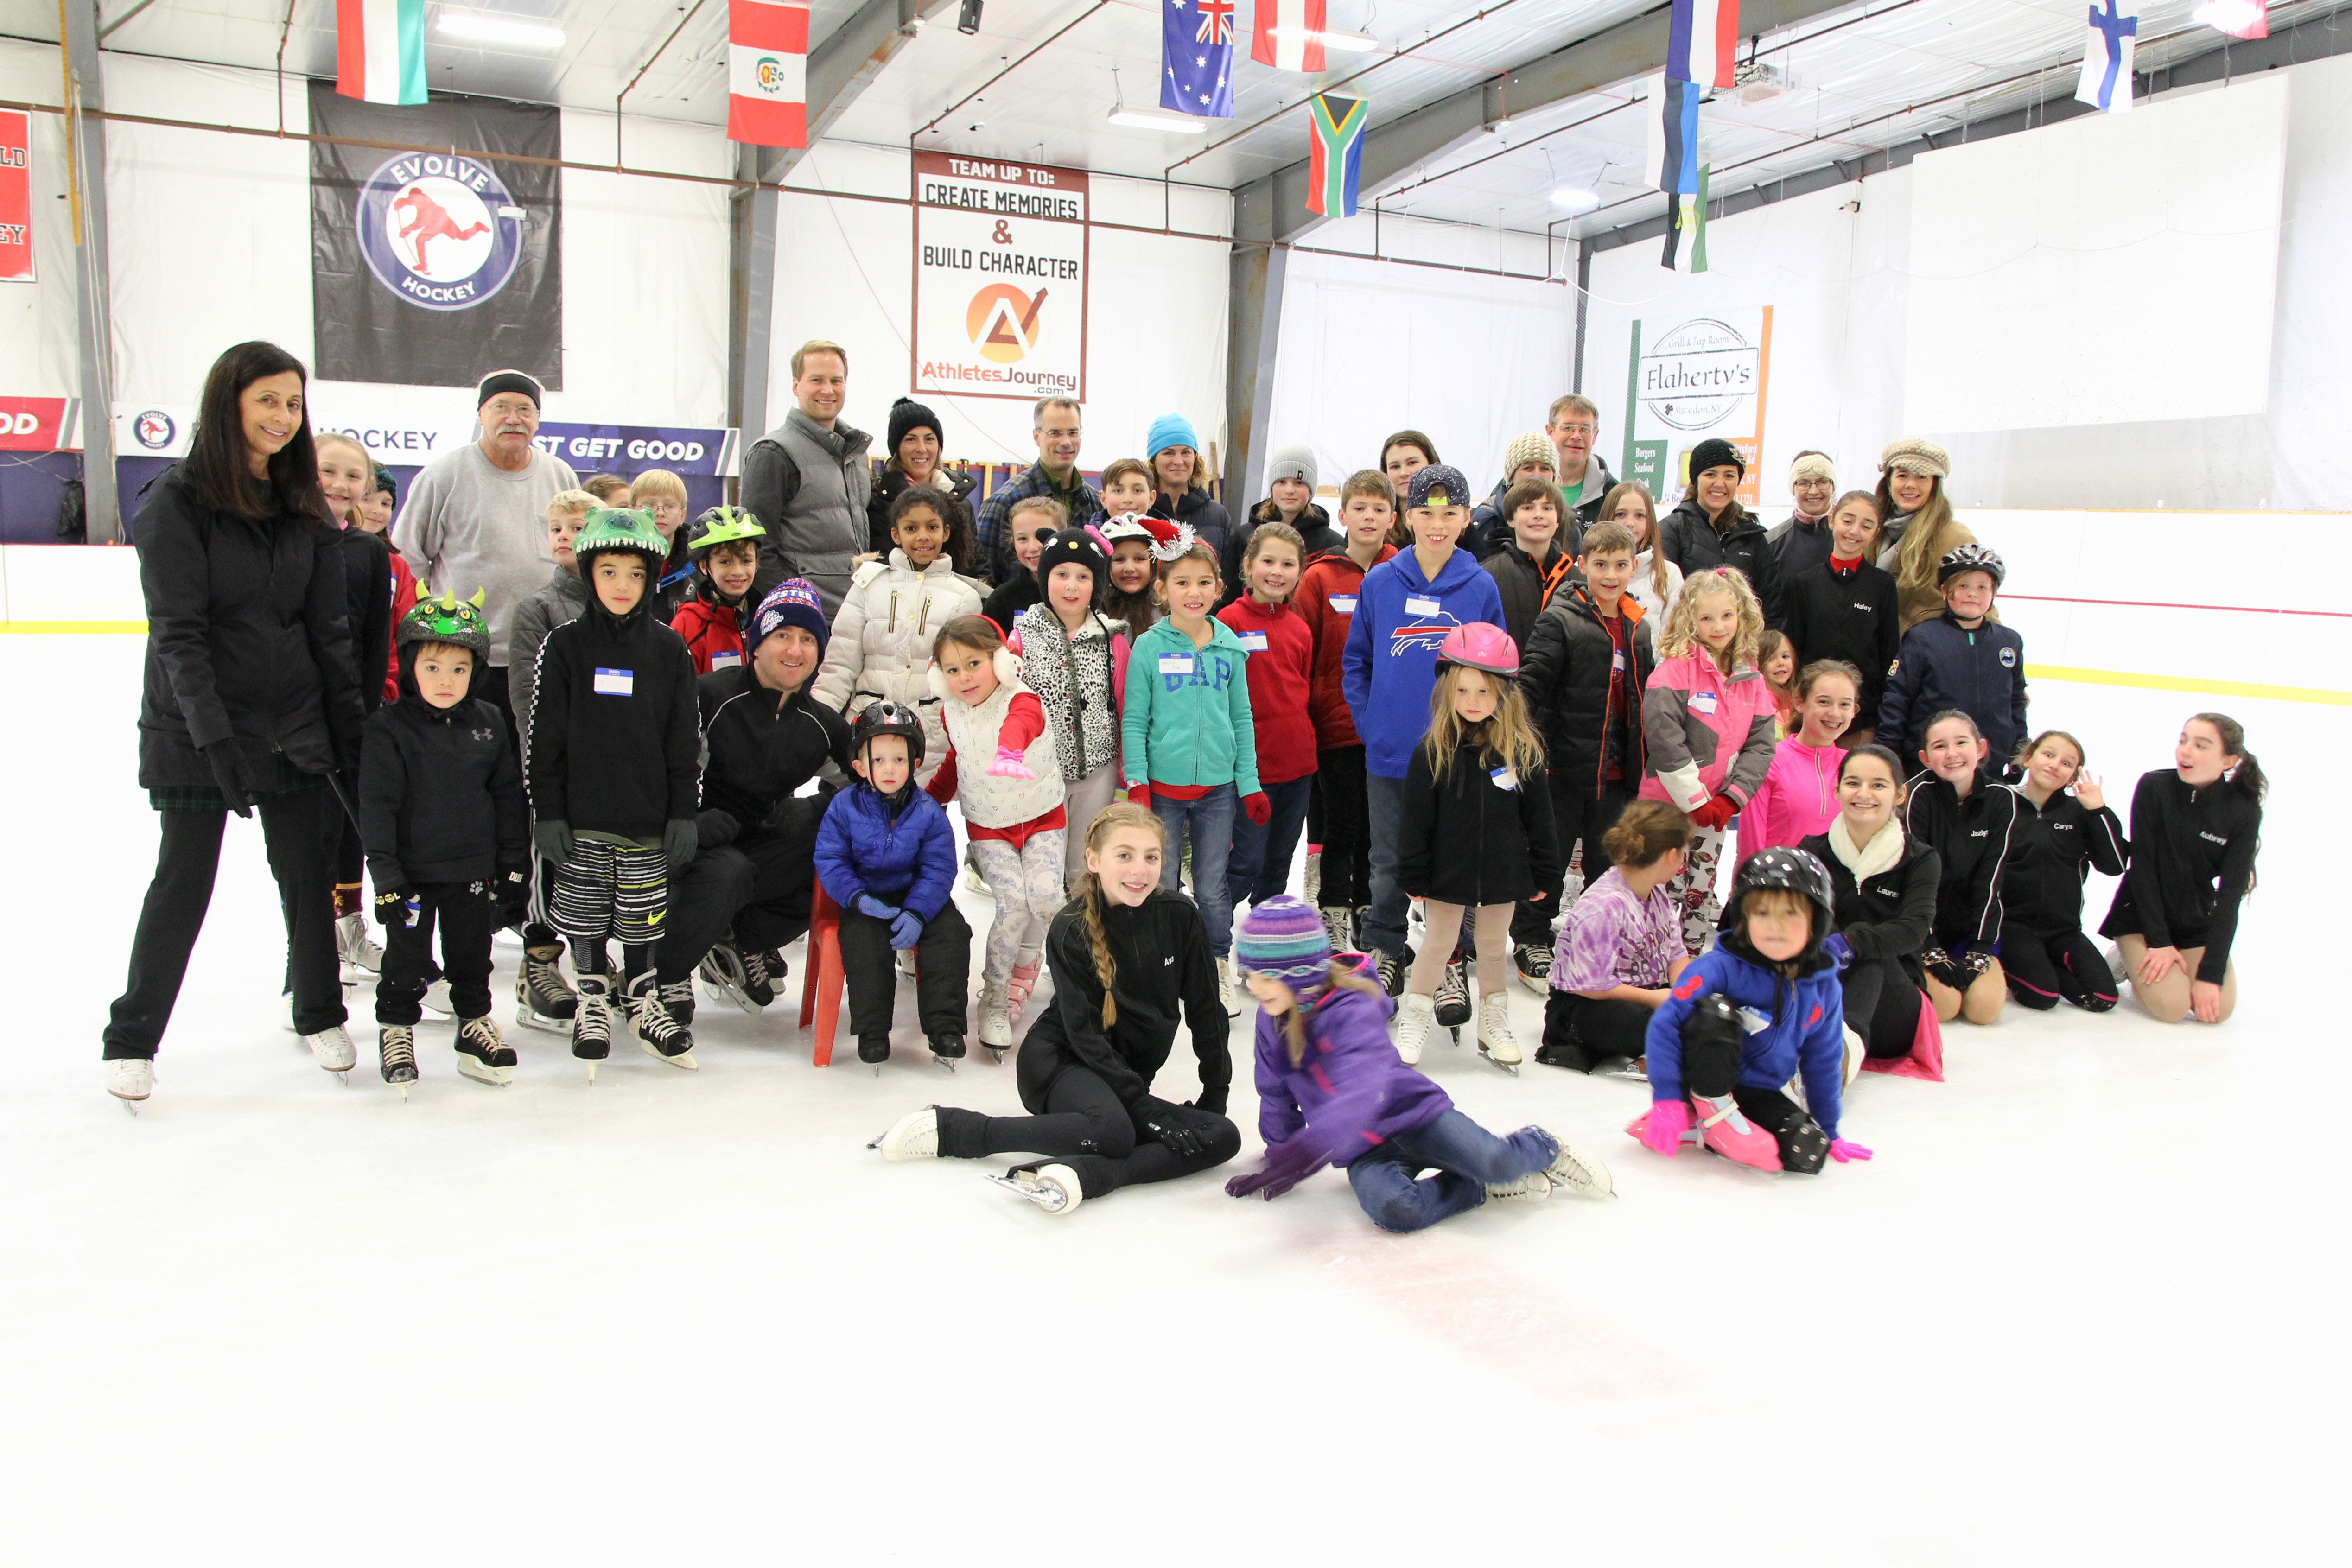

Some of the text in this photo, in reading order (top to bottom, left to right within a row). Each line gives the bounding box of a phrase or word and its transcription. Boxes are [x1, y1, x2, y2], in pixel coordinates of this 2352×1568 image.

[390, 155, 489, 192] EVOLVE
[949, 159, 1055, 185] TEAM UP TO:
[926, 183, 1078, 219] CREATE MEMORIES
[992, 219, 1013, 245] &
[924, 245, 1078, 280] BUILD CHARACTER
[401, 276, 476, 302] HOCKEY
[1669, 336, 1685, 348] Grill
[1693, 336, 1706, 349] Tap
[1708, 336, 1729, 345] Room
[922, 362, 1076, 391] AthletesJourney
[1647, 362, 1750, 394] Flaherty's
[1033, 387, 1064, 395] .com
[140, 412, 167, 420] EVOLVE
[1675, 403, 1722, 415] Macedon, NY
[568, 437, 624, 458] GET
[627, 439, 704, 462] GOOD
[1635, 447, 1656, 460] Burgers
[1747, 454, 1756, 464] Rd
[1634, 462, 1654, 473] Seafood
[1746, 474, 1756, 484] NY
[1854, 602, 1872, 612] Haley
[2053, 823, 2073, 831] Carys
[2199, 830, 2228, 846] Aubrey
[1673, 975, 1703, 1000] 3
